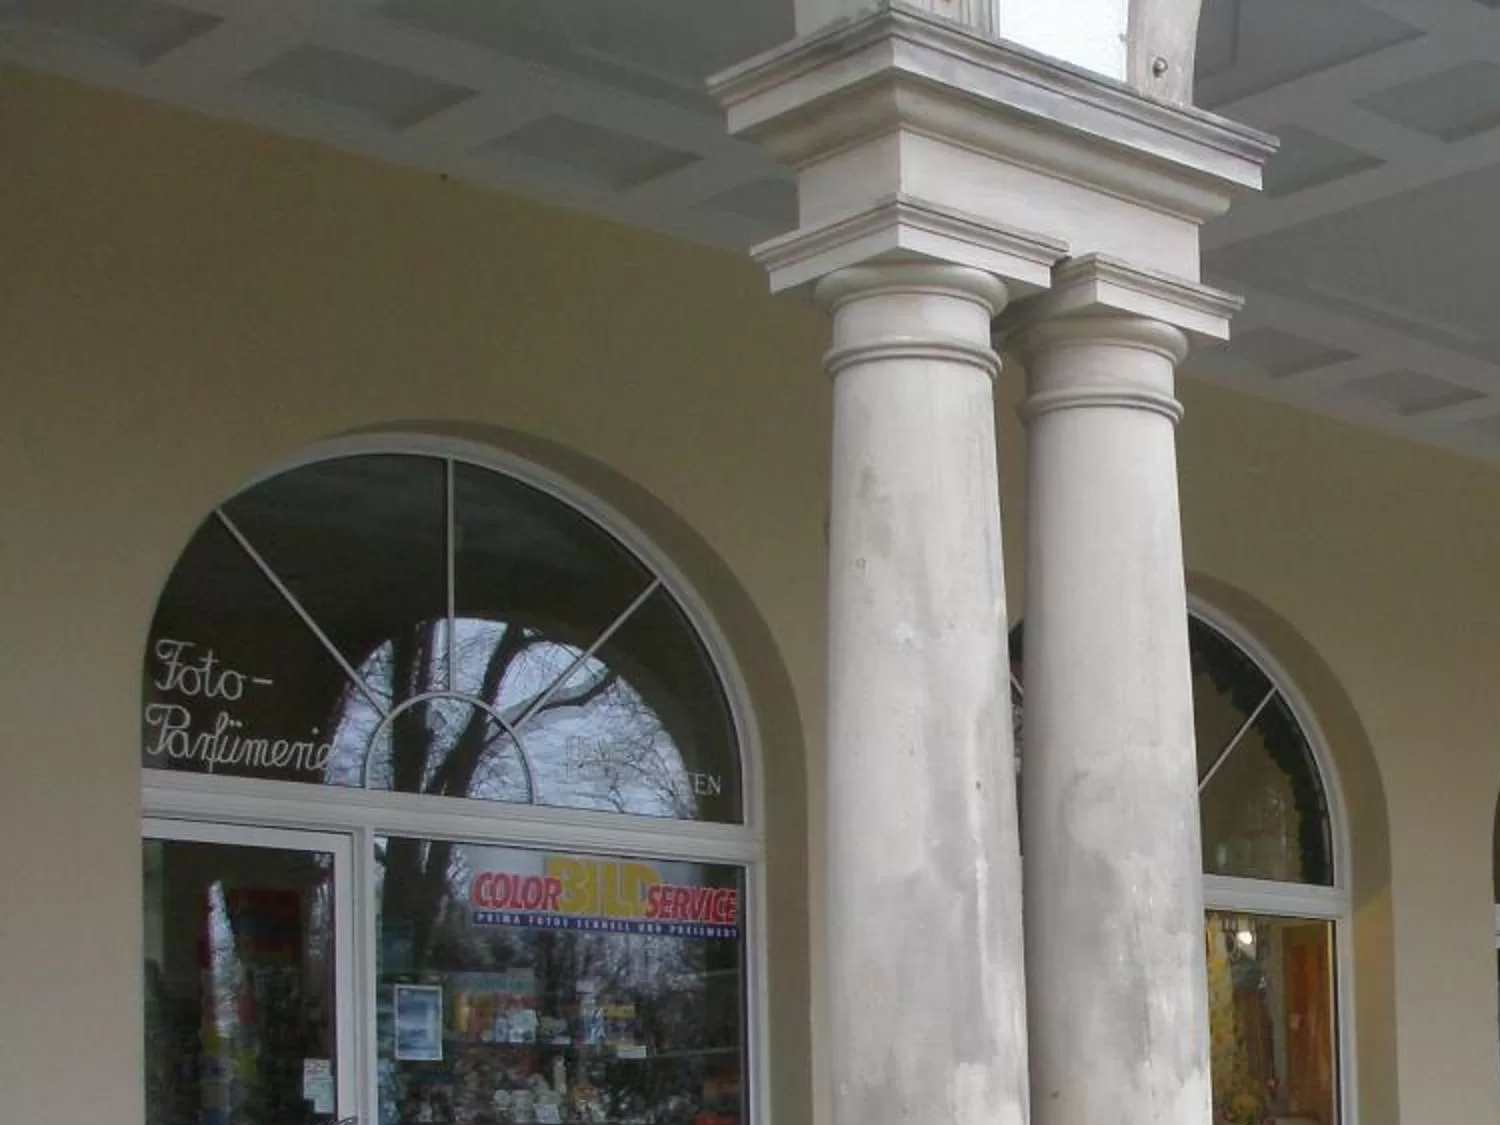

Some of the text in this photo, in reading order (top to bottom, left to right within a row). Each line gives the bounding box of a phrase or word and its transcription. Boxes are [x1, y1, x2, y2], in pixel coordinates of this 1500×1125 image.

[155, 638, 273, 701] Foto-
[474, 856, 737, 923] COLOR BILD SERVICE
[476, 912, 521, 925] PRIMA
